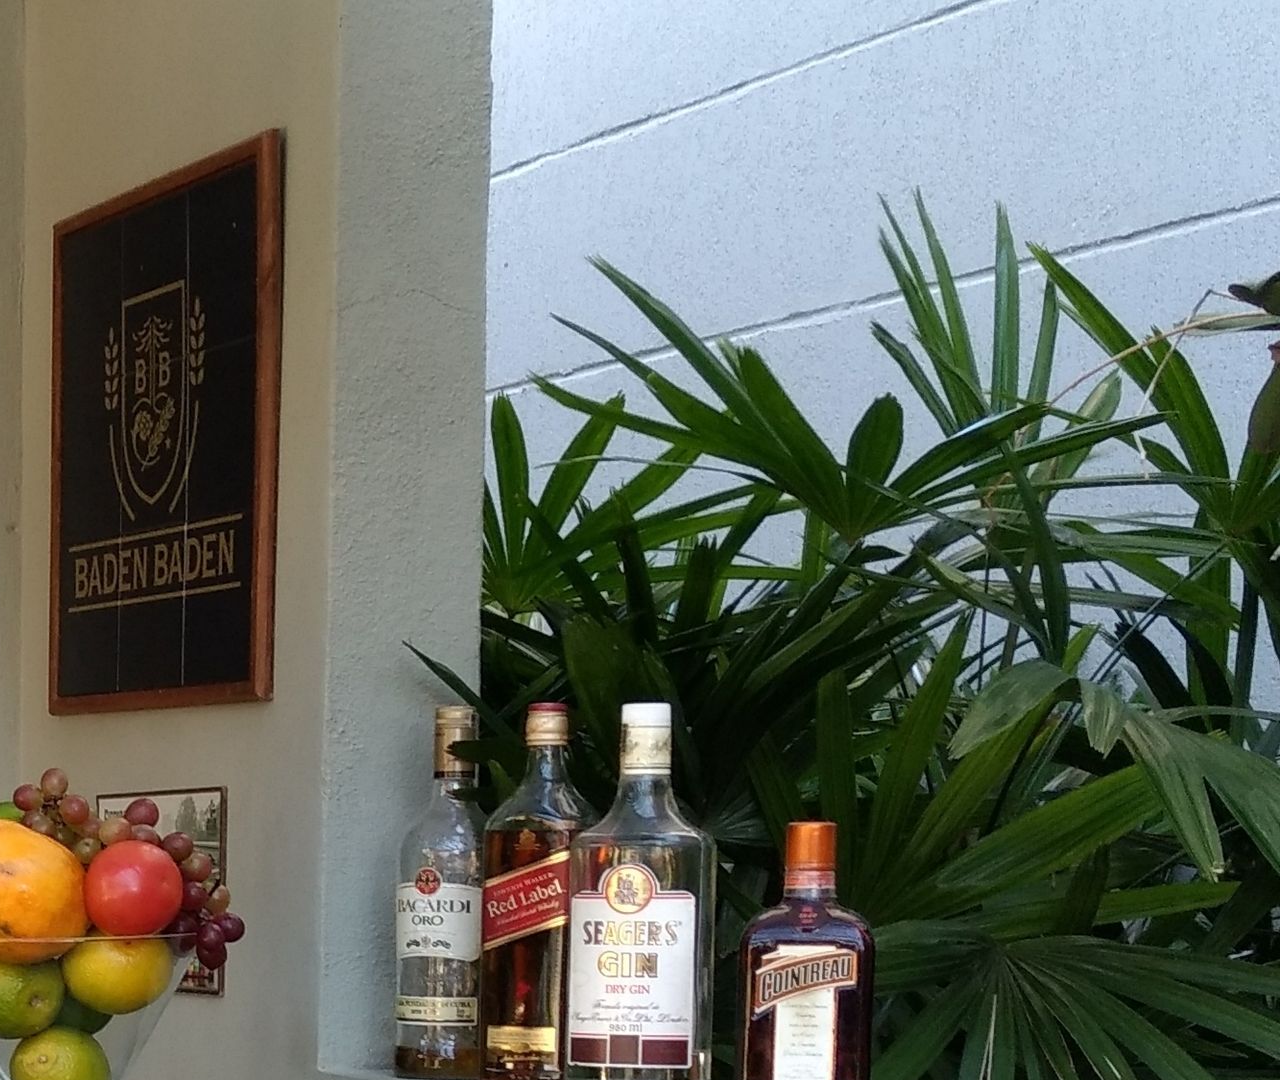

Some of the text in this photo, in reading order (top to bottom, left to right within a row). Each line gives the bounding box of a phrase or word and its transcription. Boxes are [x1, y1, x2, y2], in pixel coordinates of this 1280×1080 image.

[75, 529, 235, 599] BADEN BADEN
[397, 899, 472, 914] BACARDI
[486, 878, 562, 918] Red Label
[412, 915, 444, 926] ORO
[597, 950, 659, 978] GIN
[605, 984, 650, 994] DRY GIN
[761, 955, 851, 1002] COINTREAU
